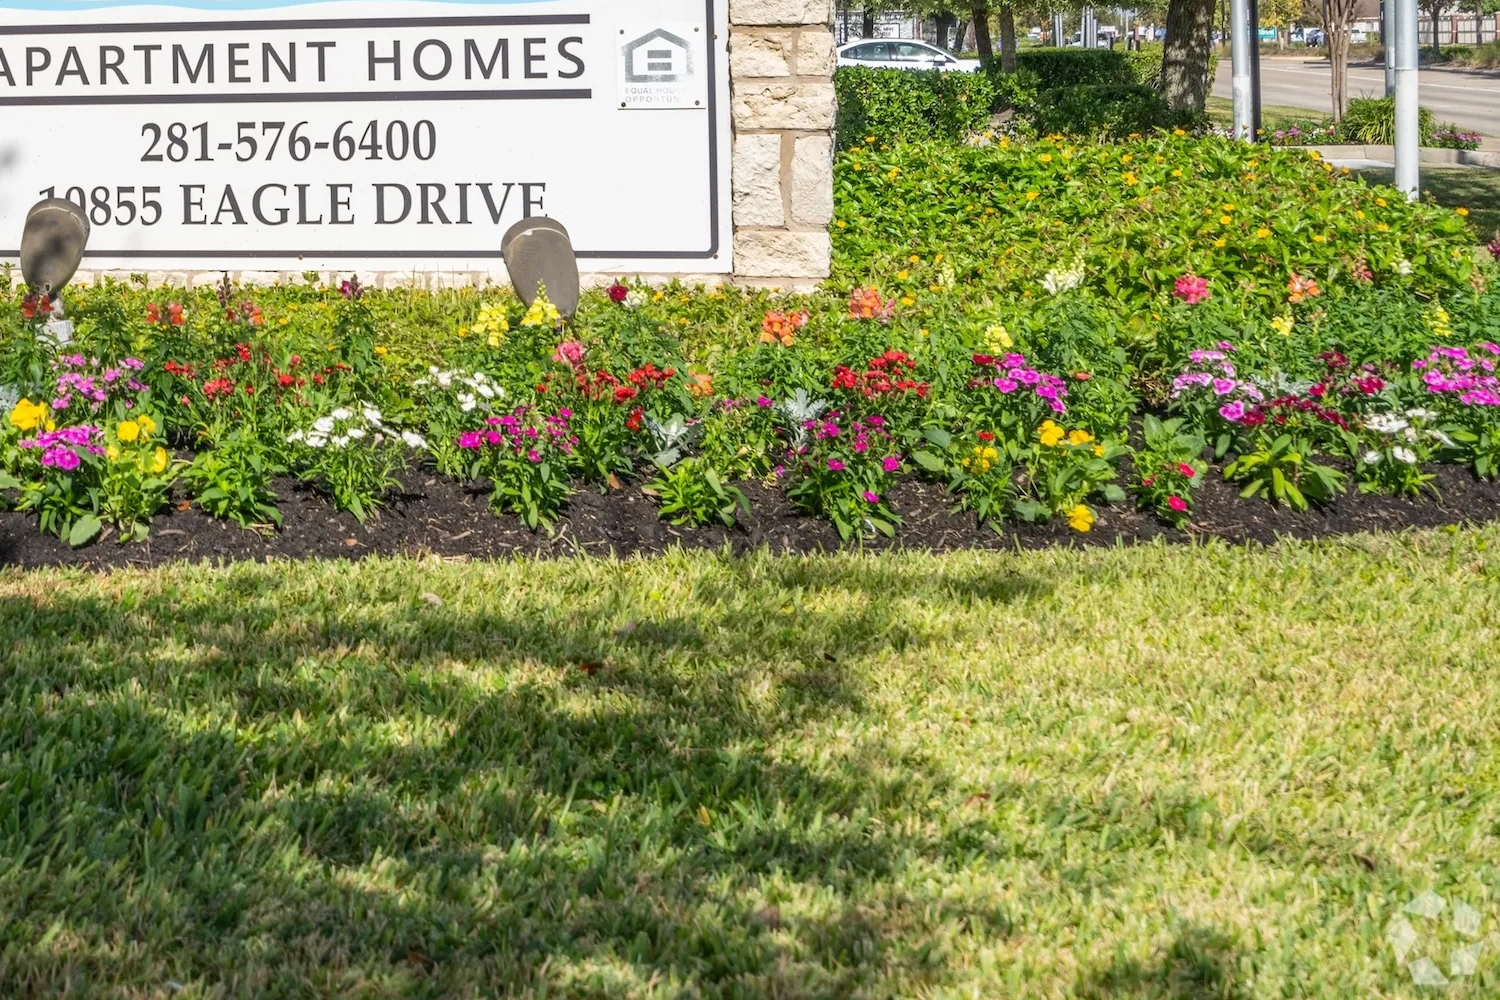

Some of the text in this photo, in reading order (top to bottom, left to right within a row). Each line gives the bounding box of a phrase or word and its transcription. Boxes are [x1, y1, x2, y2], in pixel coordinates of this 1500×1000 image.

[368, 37, 585, 81] HOMES
[625, 87, 653, 95] EQUAL
[140, 120, 436, 163] 281-576-6400
[180, 183, 355, 226] EAGLE
[373, 183, 548, 225] DRIVE
